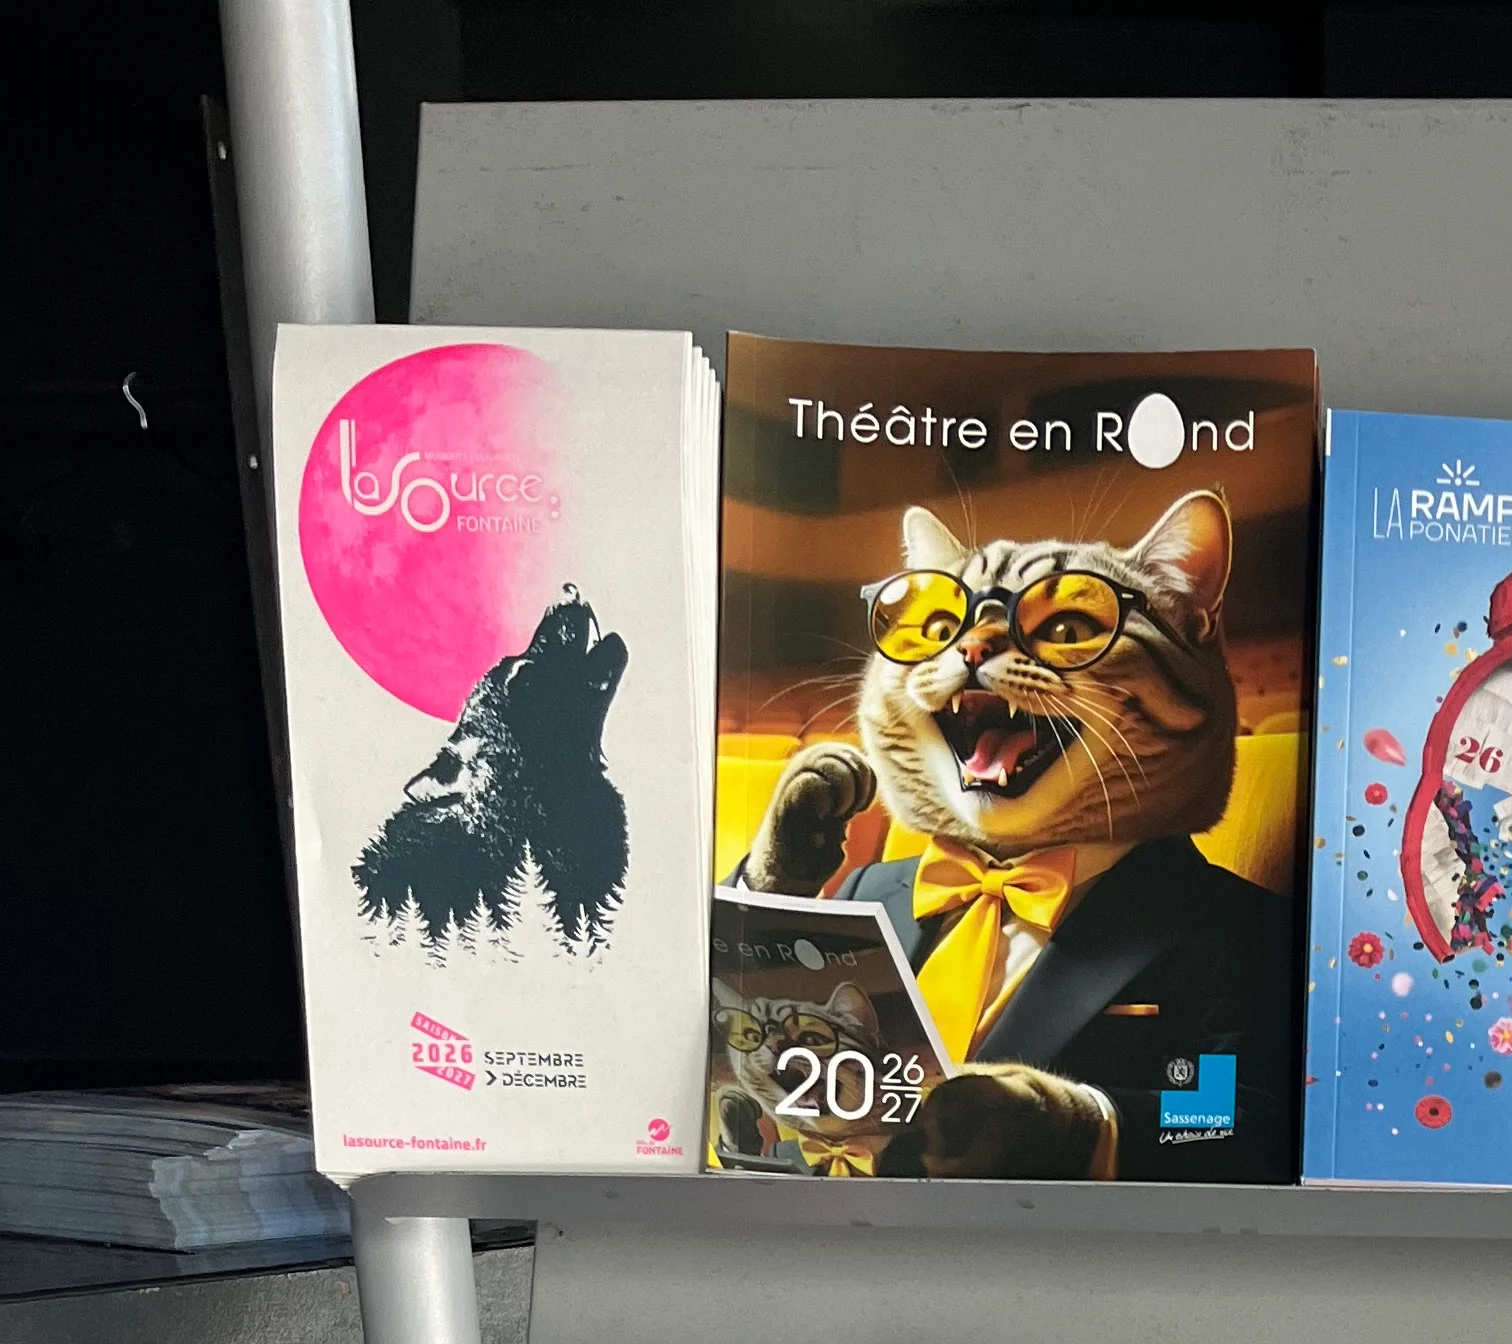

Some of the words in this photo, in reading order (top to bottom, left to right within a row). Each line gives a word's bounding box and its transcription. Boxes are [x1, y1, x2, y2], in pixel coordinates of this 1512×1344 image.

[789, 397, 988, 450] Théâtre
[1009, 417, 1072, 452] en
[457, 516, 540, 534] FONTAINE
[1373, 487, 1403, 540] LA
[1455, 737, 1503, 774] 26
[412, 1042, 473, 1063] 2026
[484, 1051, 584, 1068] SEPTEMBRE
[503, 1069, 587, 1088] DÉCEMBRE
[775, 1047, 875, 1118] 20
[882, 1053, 925, 1086] 26
[881, 1092, 922, 1124] 27
[1163, 1111, 1231, 1127] Sassenage
[343, 1134, 487, 1151] lasource-fontaine.fr
